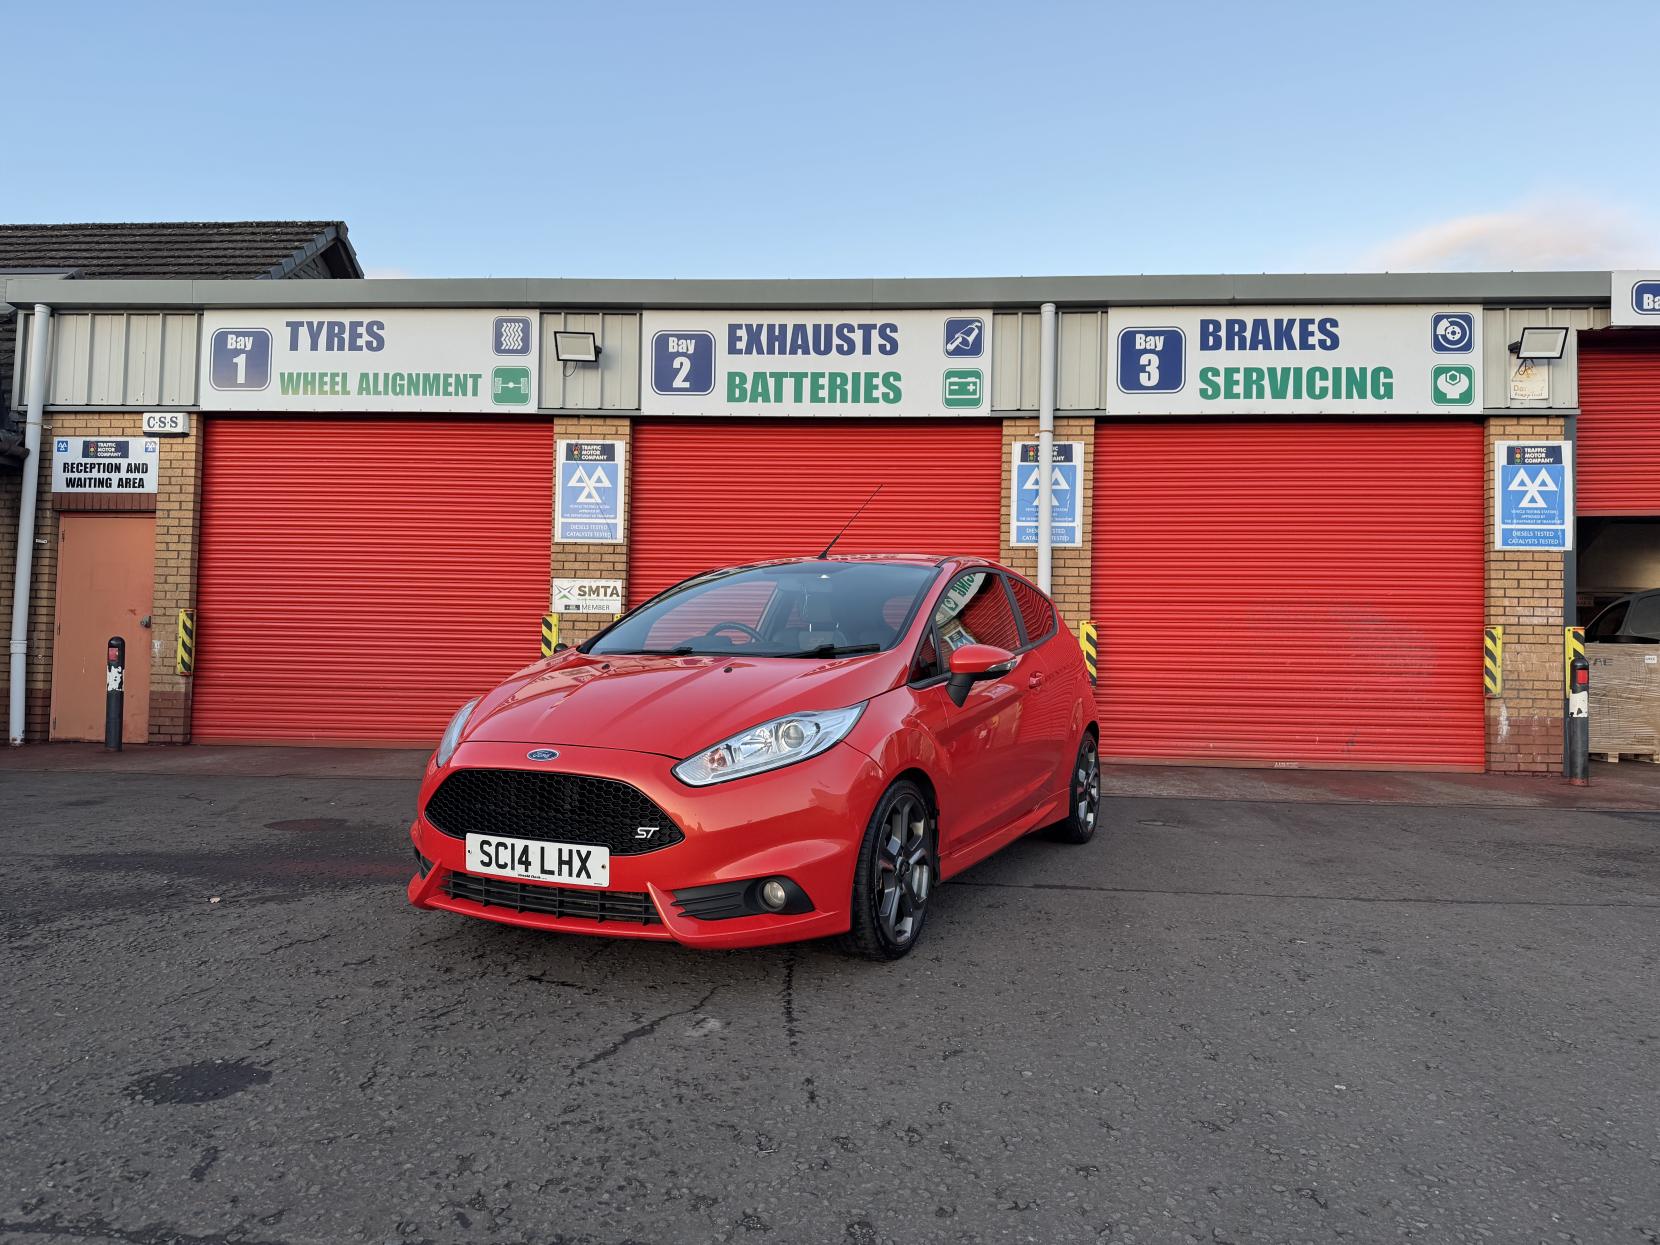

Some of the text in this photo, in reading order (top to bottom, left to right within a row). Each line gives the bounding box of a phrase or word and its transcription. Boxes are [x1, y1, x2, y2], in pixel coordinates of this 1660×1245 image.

[227, 334, 253, 350] Bay
[286, 320, 385, 352] TYRES
[668, 337, 695, 354] Bay
[727, 323, 899, 356] EXHAUSTS
[1135, 333, 1164, 351] Bay
[1200, 317, 1340, 351] BRAKES
[232, 354, 246, 384] 1
[672, 357, 691, 388] 2
[1139, 353, 1160, 386] 3
[1199, 366, 1394, 400] SERVICING
[279, 372, 482, 397] WHEEL ALIGNMENT
[727, 371, 902, 404] BATTERIES
[62, 462, 149, 474] RECEPTION AND
[65, 477, 145, 489] WAITING AREA
[577, 585, 620, 597] SMTA
[635, 827, 660, 838] ST
[479, 839, 592, 879] SC14 LHX
